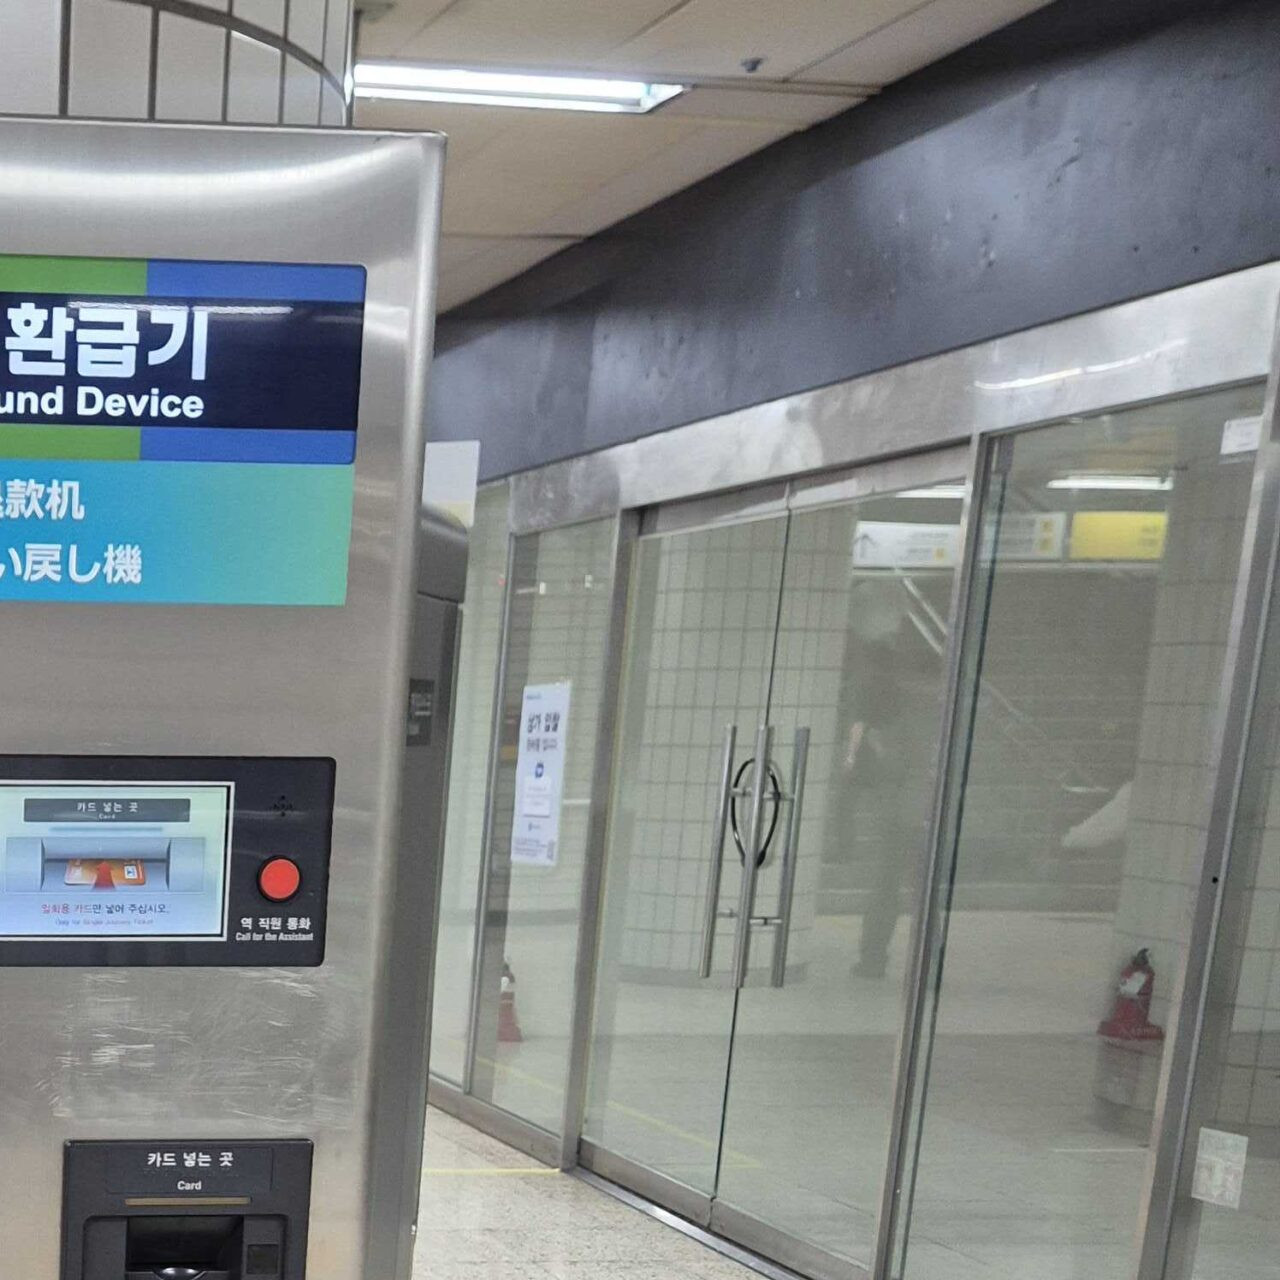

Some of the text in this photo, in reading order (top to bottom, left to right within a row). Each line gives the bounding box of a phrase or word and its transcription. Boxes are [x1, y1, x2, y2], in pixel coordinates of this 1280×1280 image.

[4, 302, 209, 381] 환급기
[76, 384, 206, 420] Device
[77, 801, 97, 813] 카드
[129, 802, 139, 813] 곳
[240, 917, 311, 930] 역 직원 통화
[235, 932, 251, 941] Call
[278, 932, 314, 941] Assistant
[147, 1151, 234, 1168] 카드 넣는 곳
[176, 1178, 202, 1191] Card
